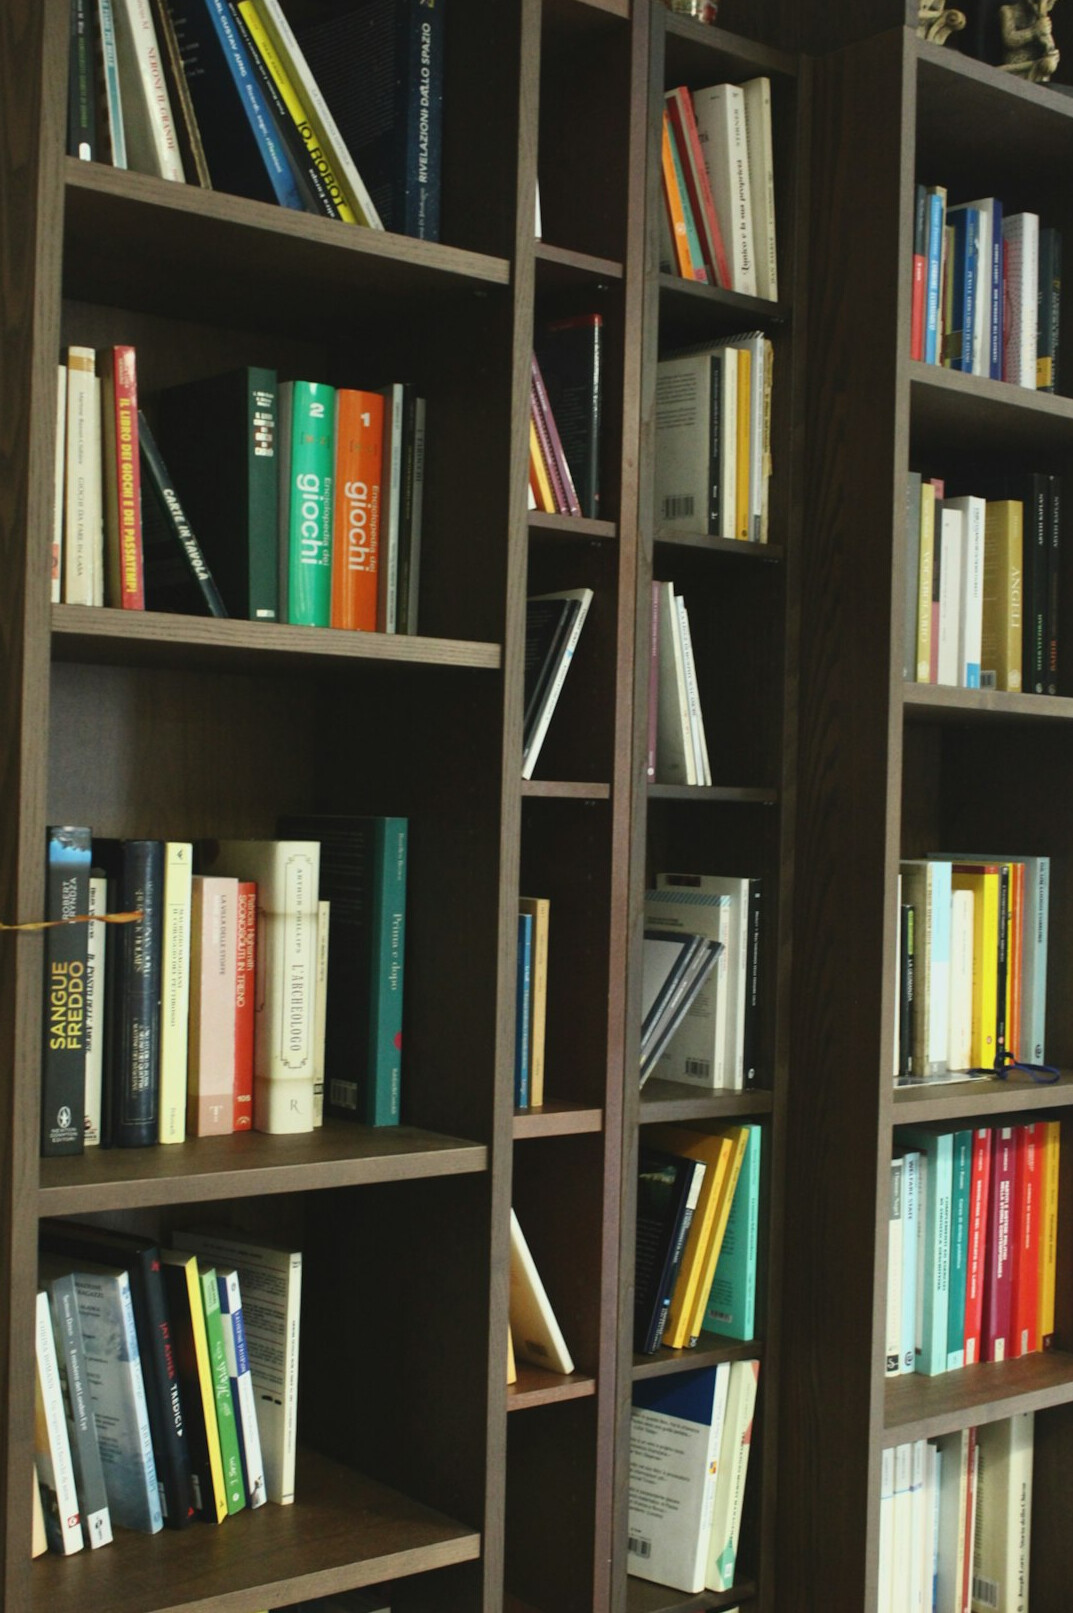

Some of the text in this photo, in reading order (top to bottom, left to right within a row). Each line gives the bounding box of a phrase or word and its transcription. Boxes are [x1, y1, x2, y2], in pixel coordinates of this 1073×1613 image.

[221, 15, 248, 78] GUSTAV JUNG
[147, 47, 175, 153] NERONE IL GRANDE
[418, 22, 432, 183] RIVELAZIONI DALLO SPAZIO
[264, 137, 283, 173] riflessioni
[308, 147, 347, 208] ROBOT
[308, 168, 326, 198] Europa
[119, 398, 130, 408] IL
[119, 410, 131, 442] LIBRO
[309, 402, 324, 418] 2
[360, 412, 370, 427] 1
[120, 443, 132, 462] DEI
[121, 463, 134, 498] GIOCHI
[123, 509, 135, 526] DEI
[163, 488, 210, 581] CARTE IN TAVOLA
[296, 473, 324, 565] giochi
[321, 477, 331, 566] Enciclopedia dei
[345, 481, 372, 571] giochi
[369, 485, 379, 572] Enciclopedia dei
[124, 528, 137, 593] PASSATEMPI
[921, 551, 930, 643] VOCABOLARIO
[1009, 566, 1021, 628] ANGELI
[62, 881, 71, 920] ROBERT
[219, 895, 227, 904] LA
[219, 905, 227, 926] VILLA
[294, 868, 303, 954] ARTHUR PHILLIPS
[219, 926, 227, 948] DELLE
[235, 894, 248, 1008] SCONOSCIUTI IN TRENO
[245, 893, 256, 971] Patricia Highsmith
[388, 913, 403, 991] Prima e dopo
[49, 961, 68, 1050] SANGUE
[67, 961, 84, 1050] FREDDO
[289, 964, 304, 1052] L'ARCHEOLOGO
[907, 1159, 915, 1195] WELFARE
[75, 1389, 86, 1415] London
[169, 1384, 182, 1427] TREDICI
